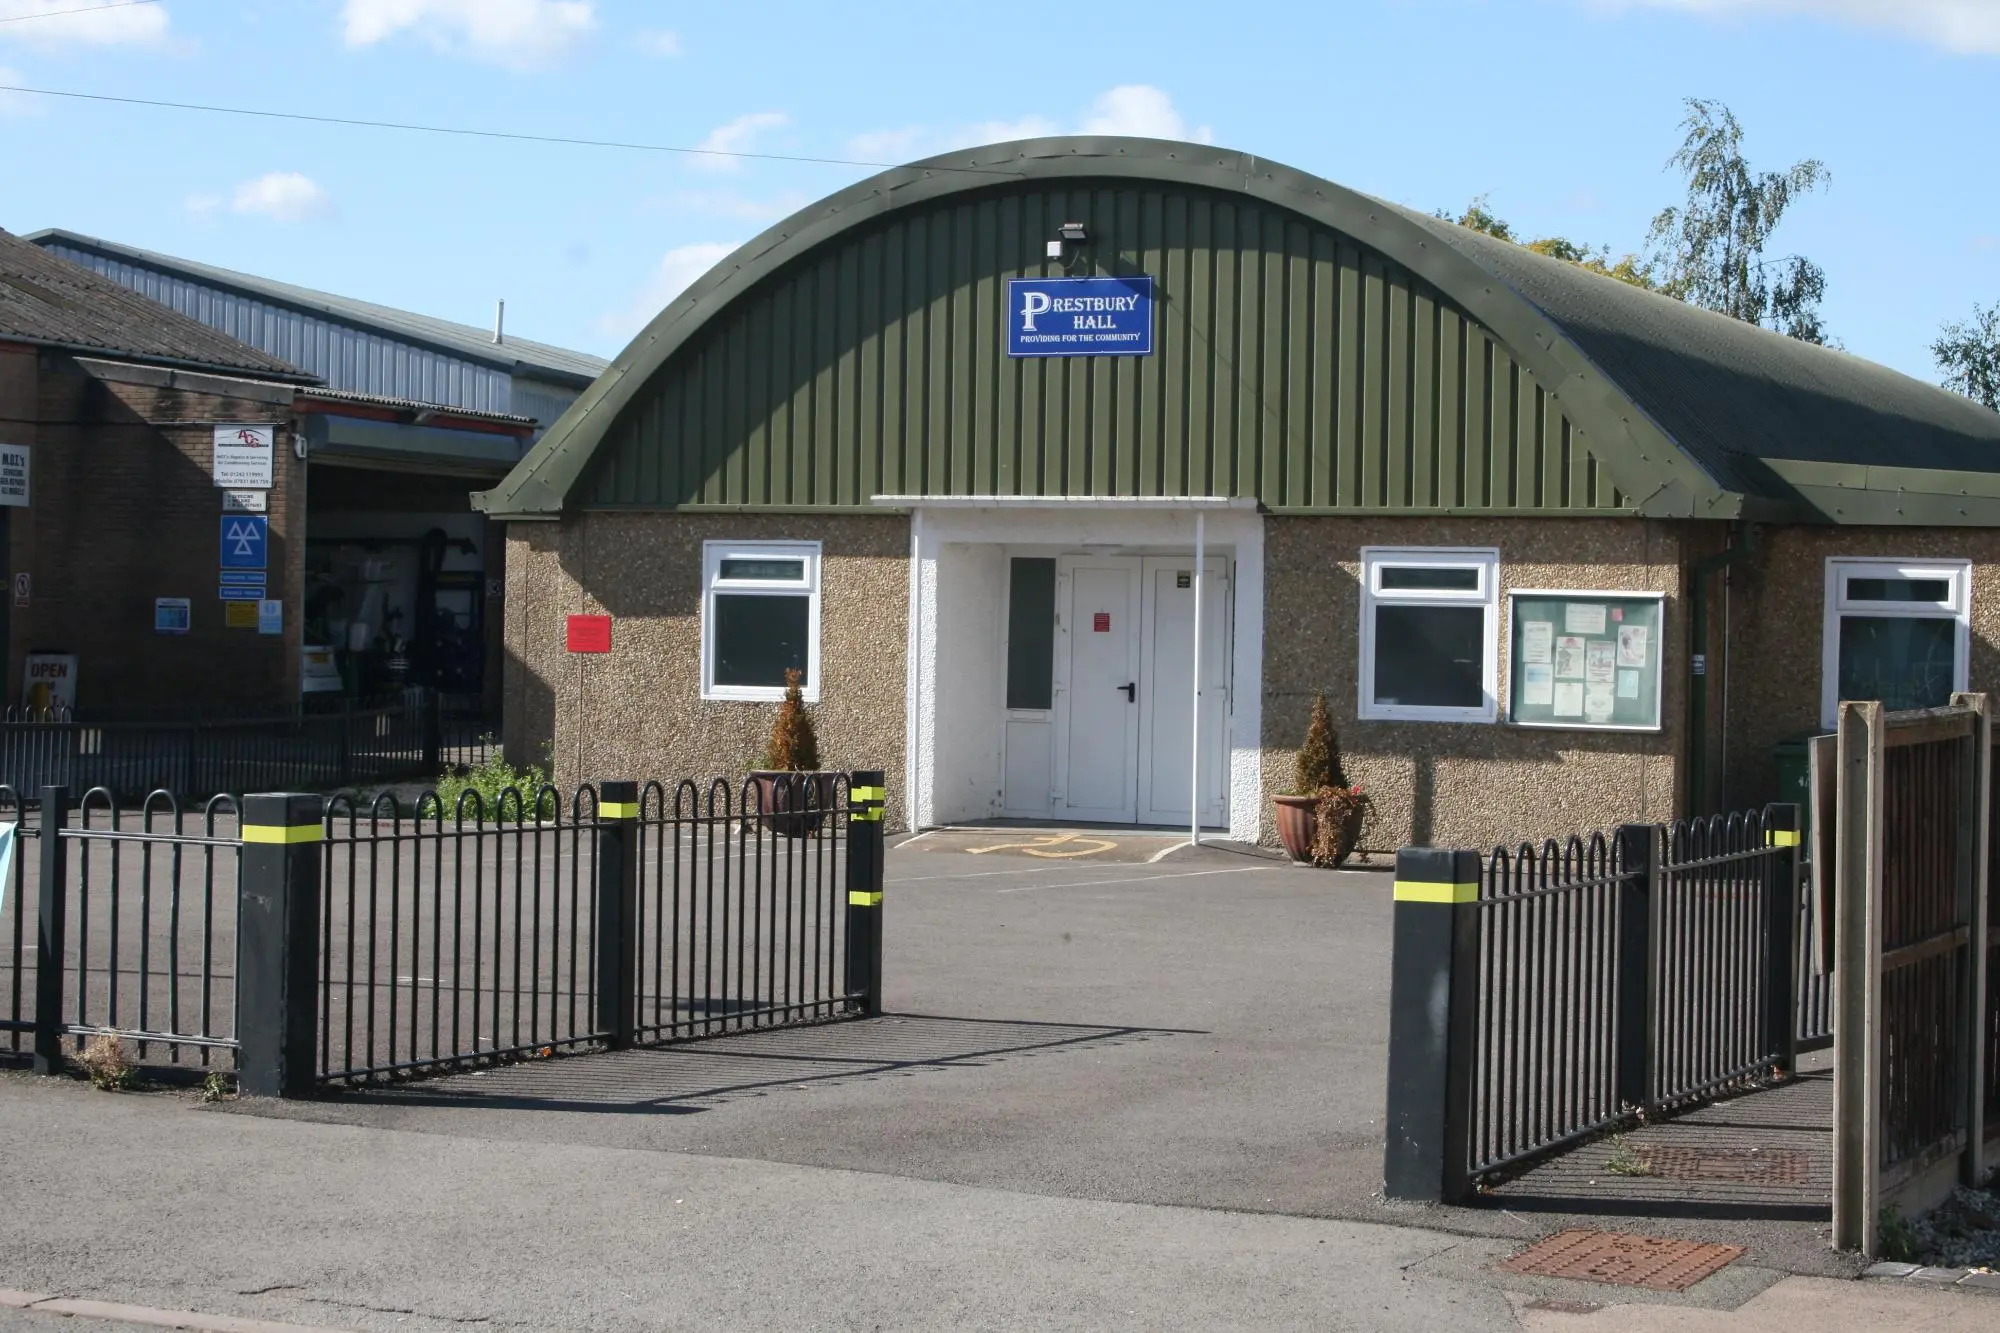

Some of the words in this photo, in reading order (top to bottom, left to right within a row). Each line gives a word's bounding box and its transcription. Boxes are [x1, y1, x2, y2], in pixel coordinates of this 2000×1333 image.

[1020, 292, 1140, 332] PRESTBURY
[1073, 314, 1117, 329] HALL
[1020, 334, 1061, 343] PROVIDING
[1062, 334, 1077, 342] FOR
[1095, 332, 1141, 341] COMMUNITY
[31, 663, 68, 678] OPEN
